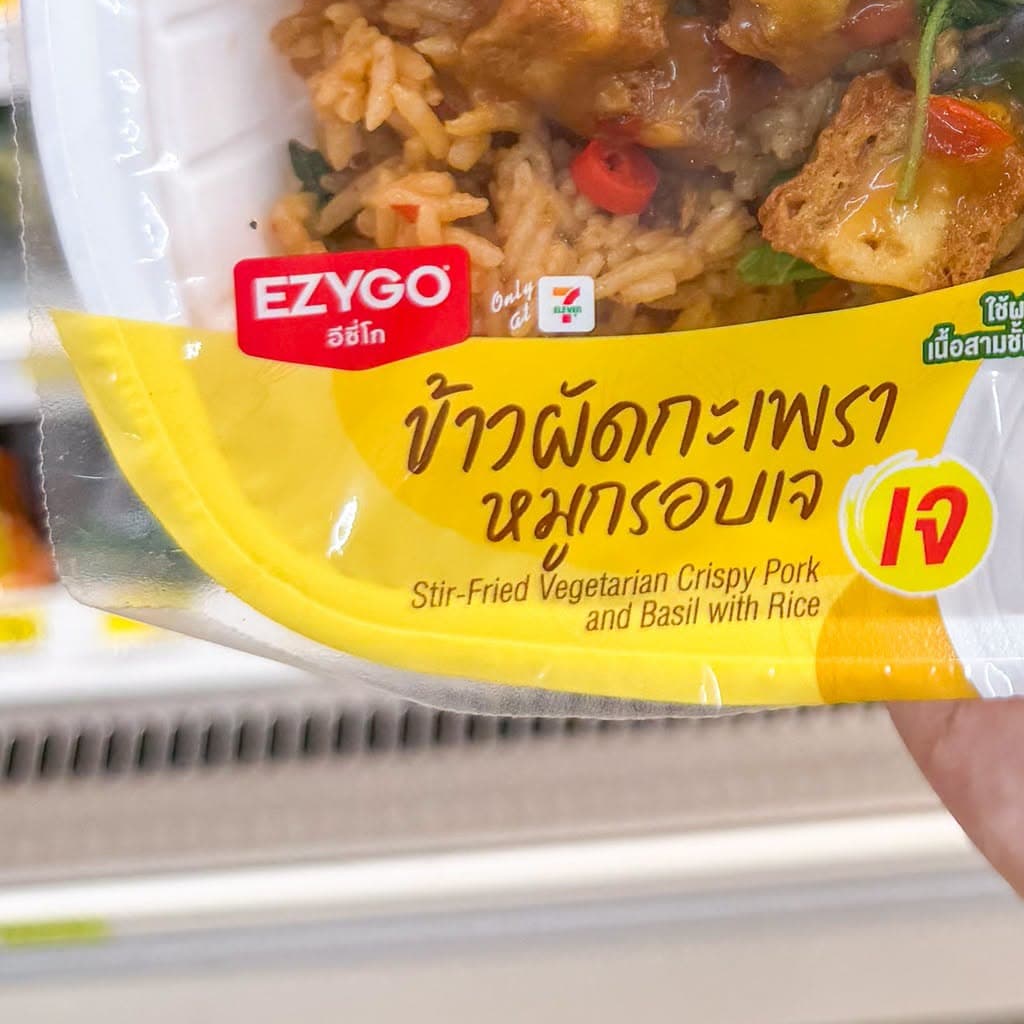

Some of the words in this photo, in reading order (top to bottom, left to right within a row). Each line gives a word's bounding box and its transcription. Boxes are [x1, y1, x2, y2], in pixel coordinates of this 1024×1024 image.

[255, 265, 451, 320] EZYGO
[491, 279, 534, 313] Only
[510, 301, 531, 330] at
[325, 320, 386, 347] อีซี่โก
[404, 372, 898, 476] ข้าวผัดกะเพรา
[481, 470, 823, 572] หมูกรอบเจ
[880, 485, 969, 566] เจ
[411, 574, 529, 610] Stir-Fried
[540, 567, 668, 605] Vegetarian
[677, 562, 757, 594] Crispy
[764, 555, 821, 585] Pork
[586, 602, 632, 632] and
[639, 597, 700, 629] Basil
[708, 593, 760, 624] with
[768, 590, 821, 620] Rice
